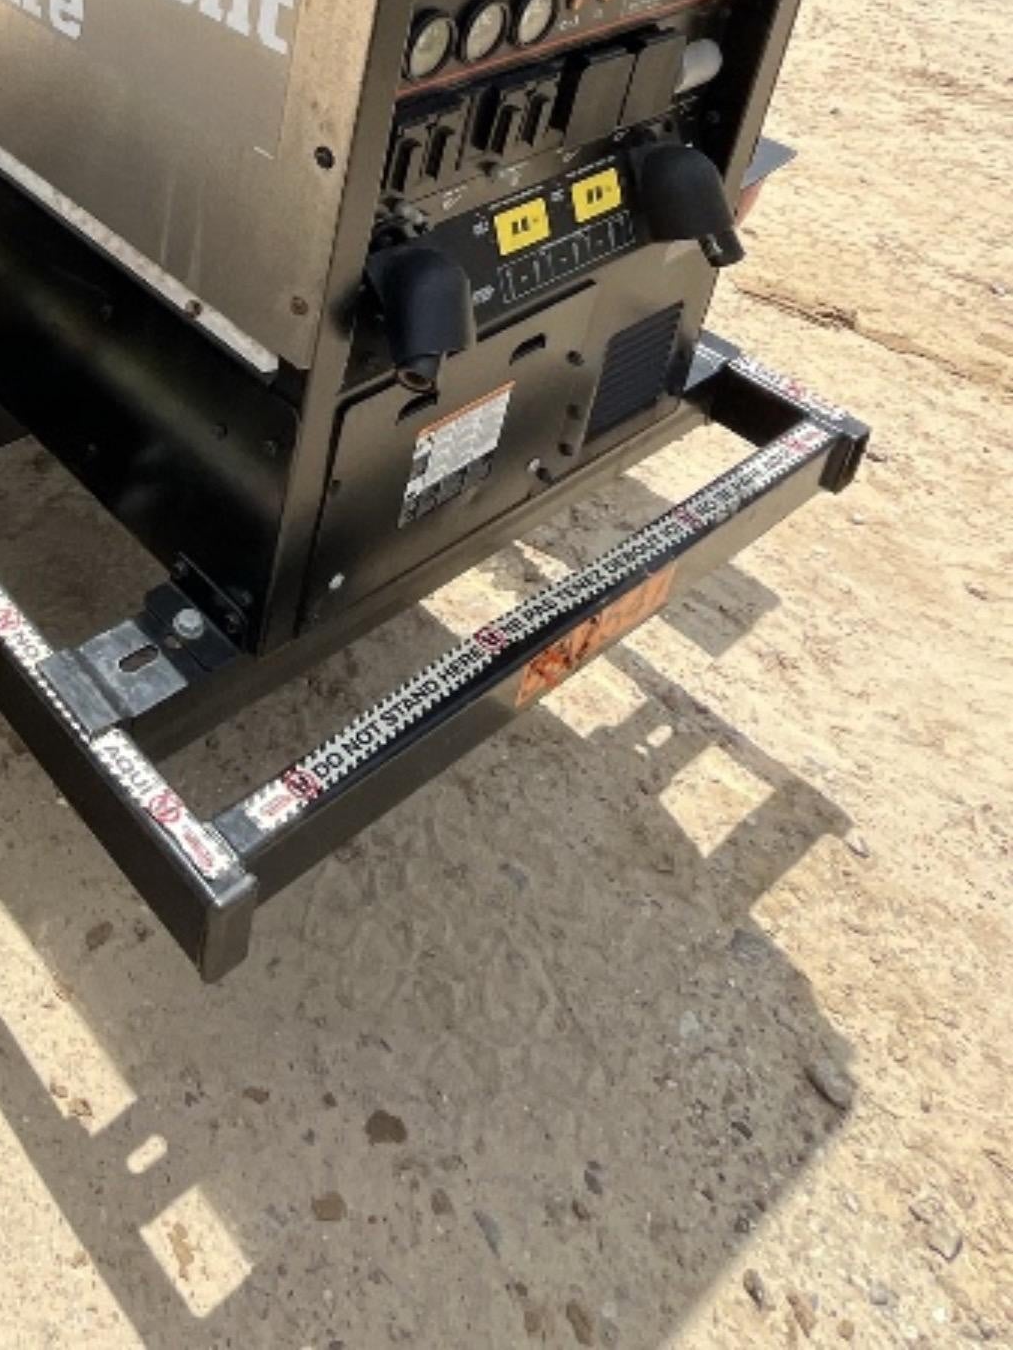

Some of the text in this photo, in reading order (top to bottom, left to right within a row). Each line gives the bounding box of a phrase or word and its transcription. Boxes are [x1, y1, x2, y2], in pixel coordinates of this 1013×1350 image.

[311, 645, 483, 779] DO NOT STAND HERE
